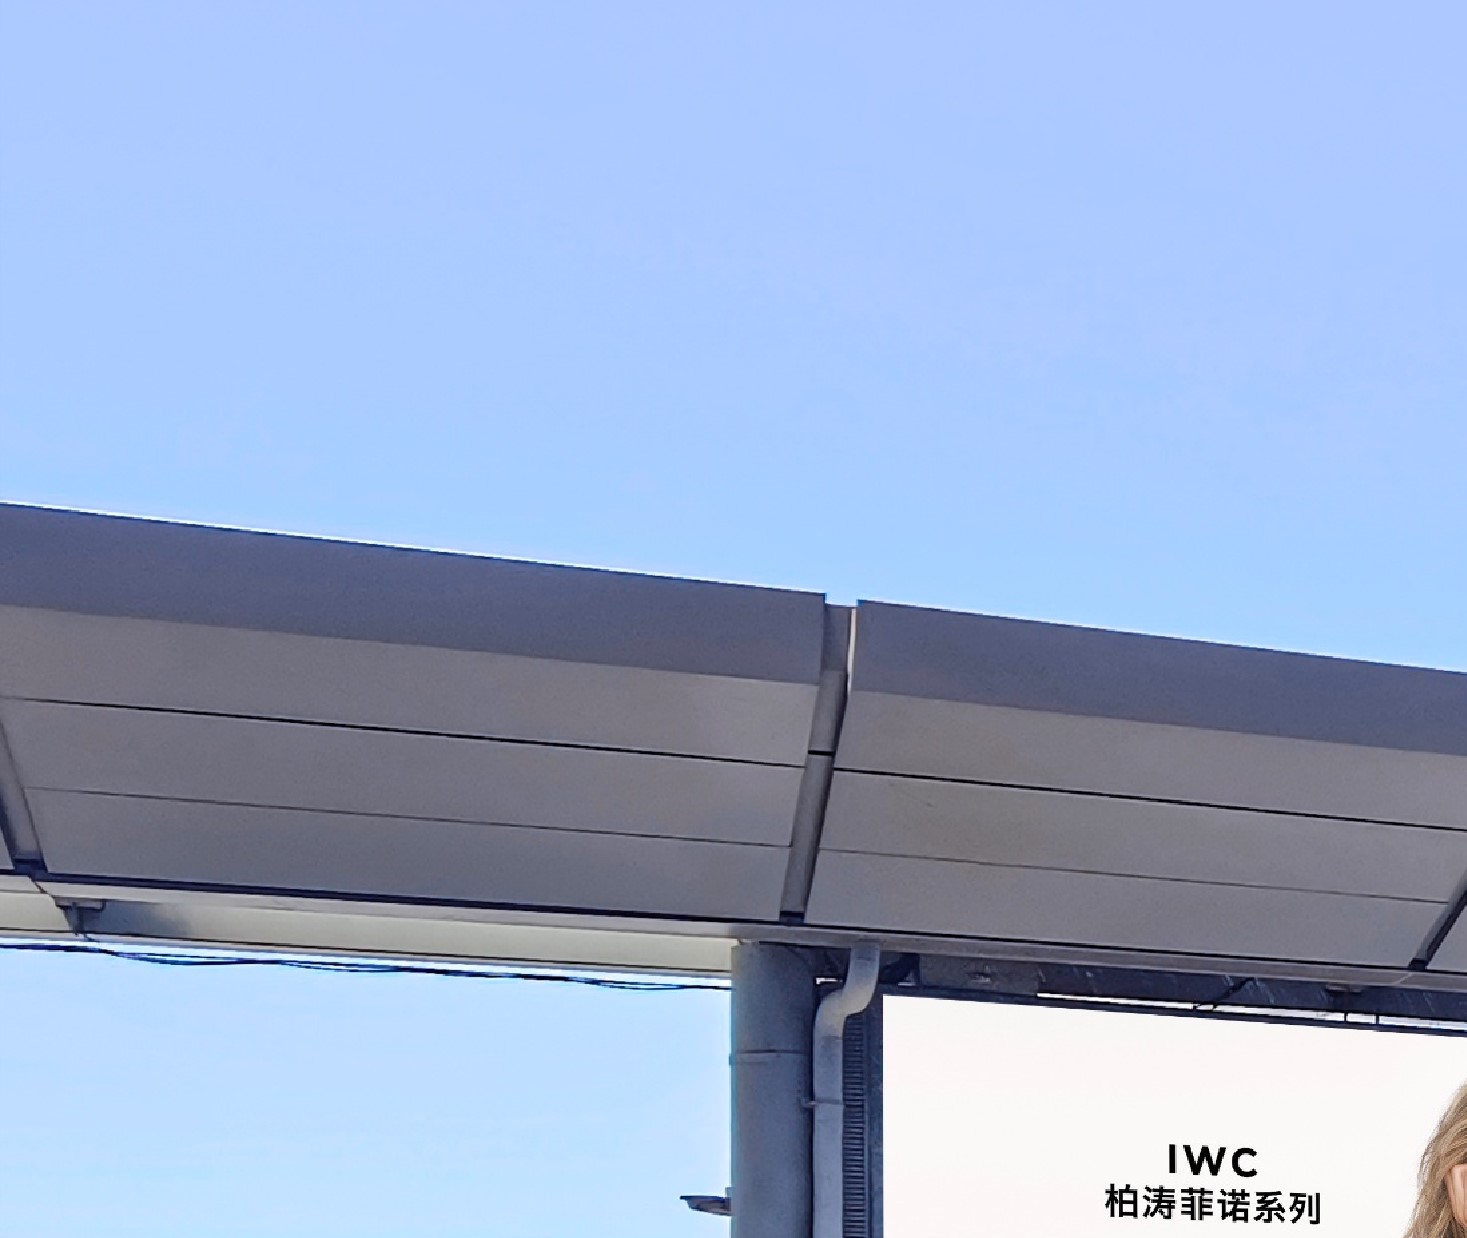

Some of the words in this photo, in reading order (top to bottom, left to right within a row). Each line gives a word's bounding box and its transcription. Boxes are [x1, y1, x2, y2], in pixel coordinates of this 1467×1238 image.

[1168, 1144, 1258, 1178] IWC
[1104, 1183, 1321, 1225] 柏涛菲诺系列
